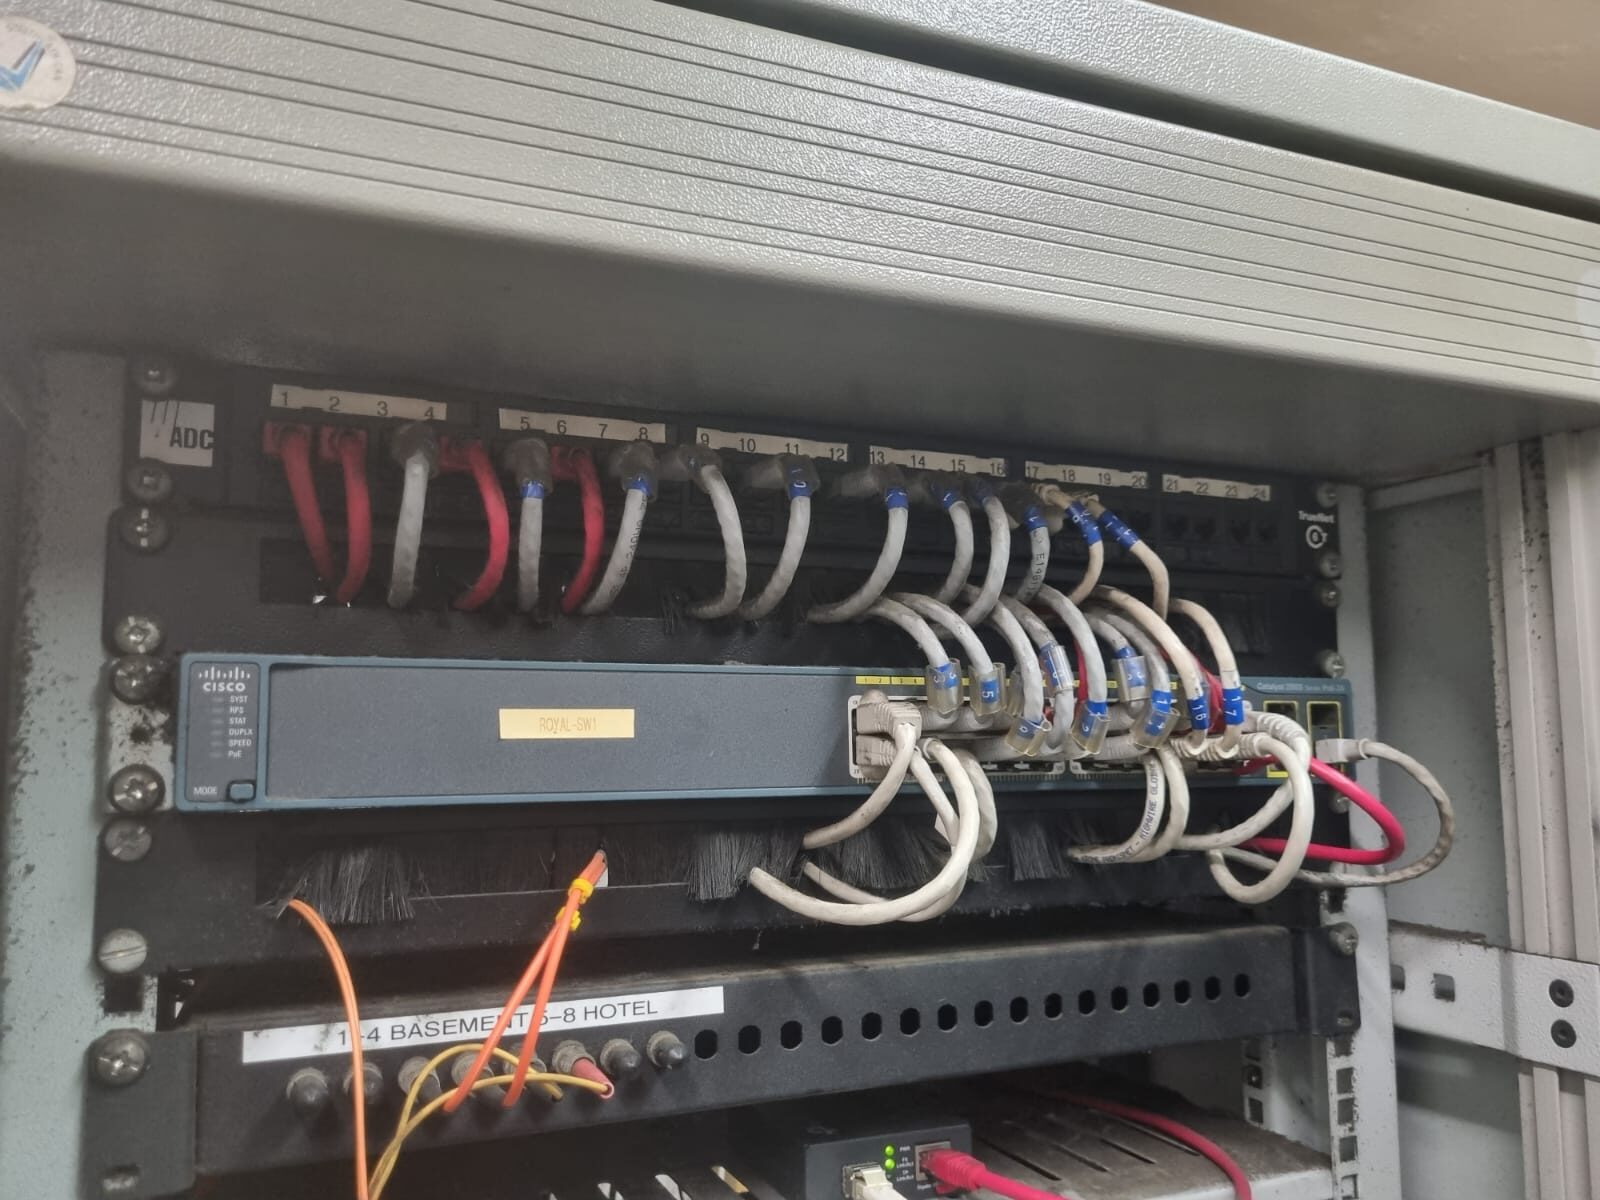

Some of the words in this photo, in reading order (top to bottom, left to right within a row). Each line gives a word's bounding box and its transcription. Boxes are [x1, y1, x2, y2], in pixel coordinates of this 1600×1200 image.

[280, 391, 289, 406] 1
[328, 396, 341, 412] 2
[376, 400, 389, 417] 3
[424, 406, 435, 420] 4
[169, 426, 215, 450] ADC
[520, 416, 531, 431] 5
[556, 420, 568, 435] 6
[598, 423, 609, 438] 7
[638, 426, 649, 440] 8
[700, 433, 710, 447] 9
[738, 438, 757, 452] 10
[784, 442, 800, 456] 11
[829, 447, 846, 461] 12
[870, 450, 885, 465] 13
[910, 454, 926, 467] 14
[951, 459, 966, 472] 15
[990, 462, 1004, 476] 16
[1025, 466, 1040, 479] 17
[1061, 469, 1076, 482] 18
[1097, 472, 1112, 485] 19
[1131, 475, 1146, 488] 20
[1166, 479, 1178, 491] 21
[1195, 482, 1209, 494] 22
[1225, 485, 1239, 497] 23
[1253, 487, 1266, 499] 24
[230, 695, 249, 703] SYST
[229, 717, 247, 725] STAT
[539, 717, 597, 732] ROYAL-SW1
[228, 728, 253, 736] DUPLX
[228, 739, 252, 747] SPEED
[193, 786, 218, 795] MODE
[584, 999, 659, 1021] HOTEL
